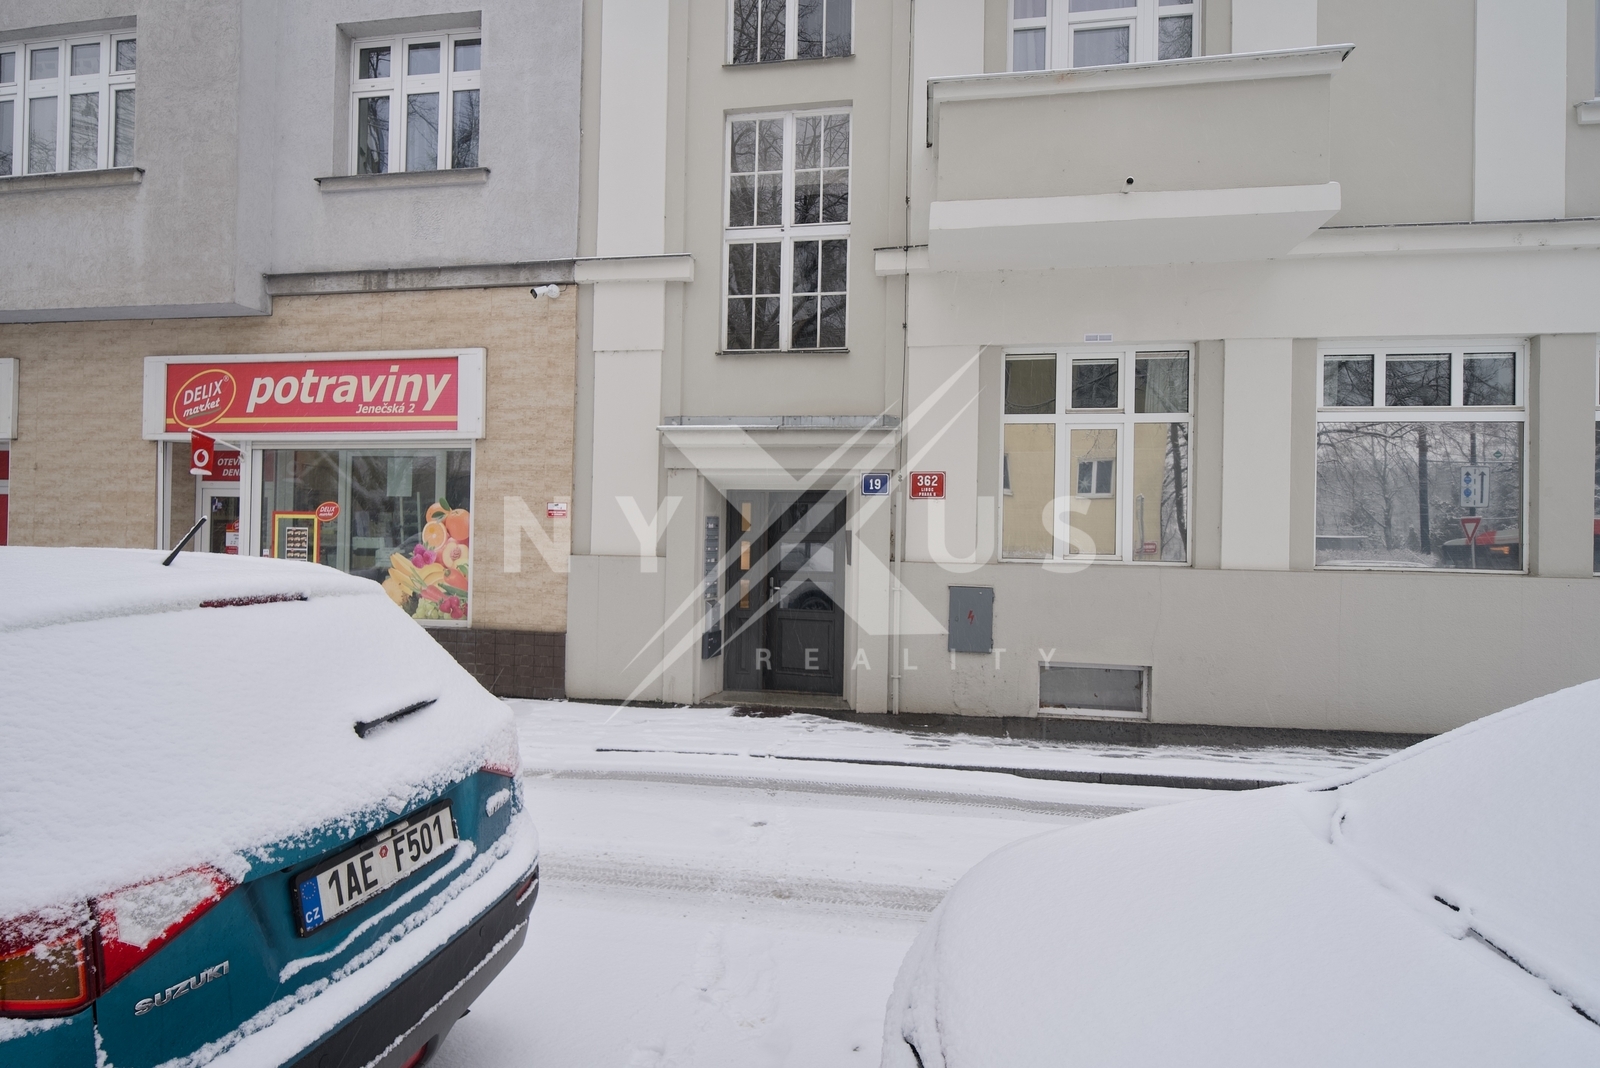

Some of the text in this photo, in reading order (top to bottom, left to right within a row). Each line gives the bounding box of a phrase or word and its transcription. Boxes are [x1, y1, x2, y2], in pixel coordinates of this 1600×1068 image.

[183, 379, 223, 405] DELIX
[246, 365, 452, 413] potraviny
[183, 398, 221, 417] market
[355, 402, 415, 414] Jenečská 2
[222, 468, 240, 476] DEN
[917, 475, 938, 486] 362
[869, 478, 881, 490] 19
[328, 815, 445, 907] 1AE F501
[305, 907, 321, 924] CZ
[134, 960, 229, 1016] SUZUKI
